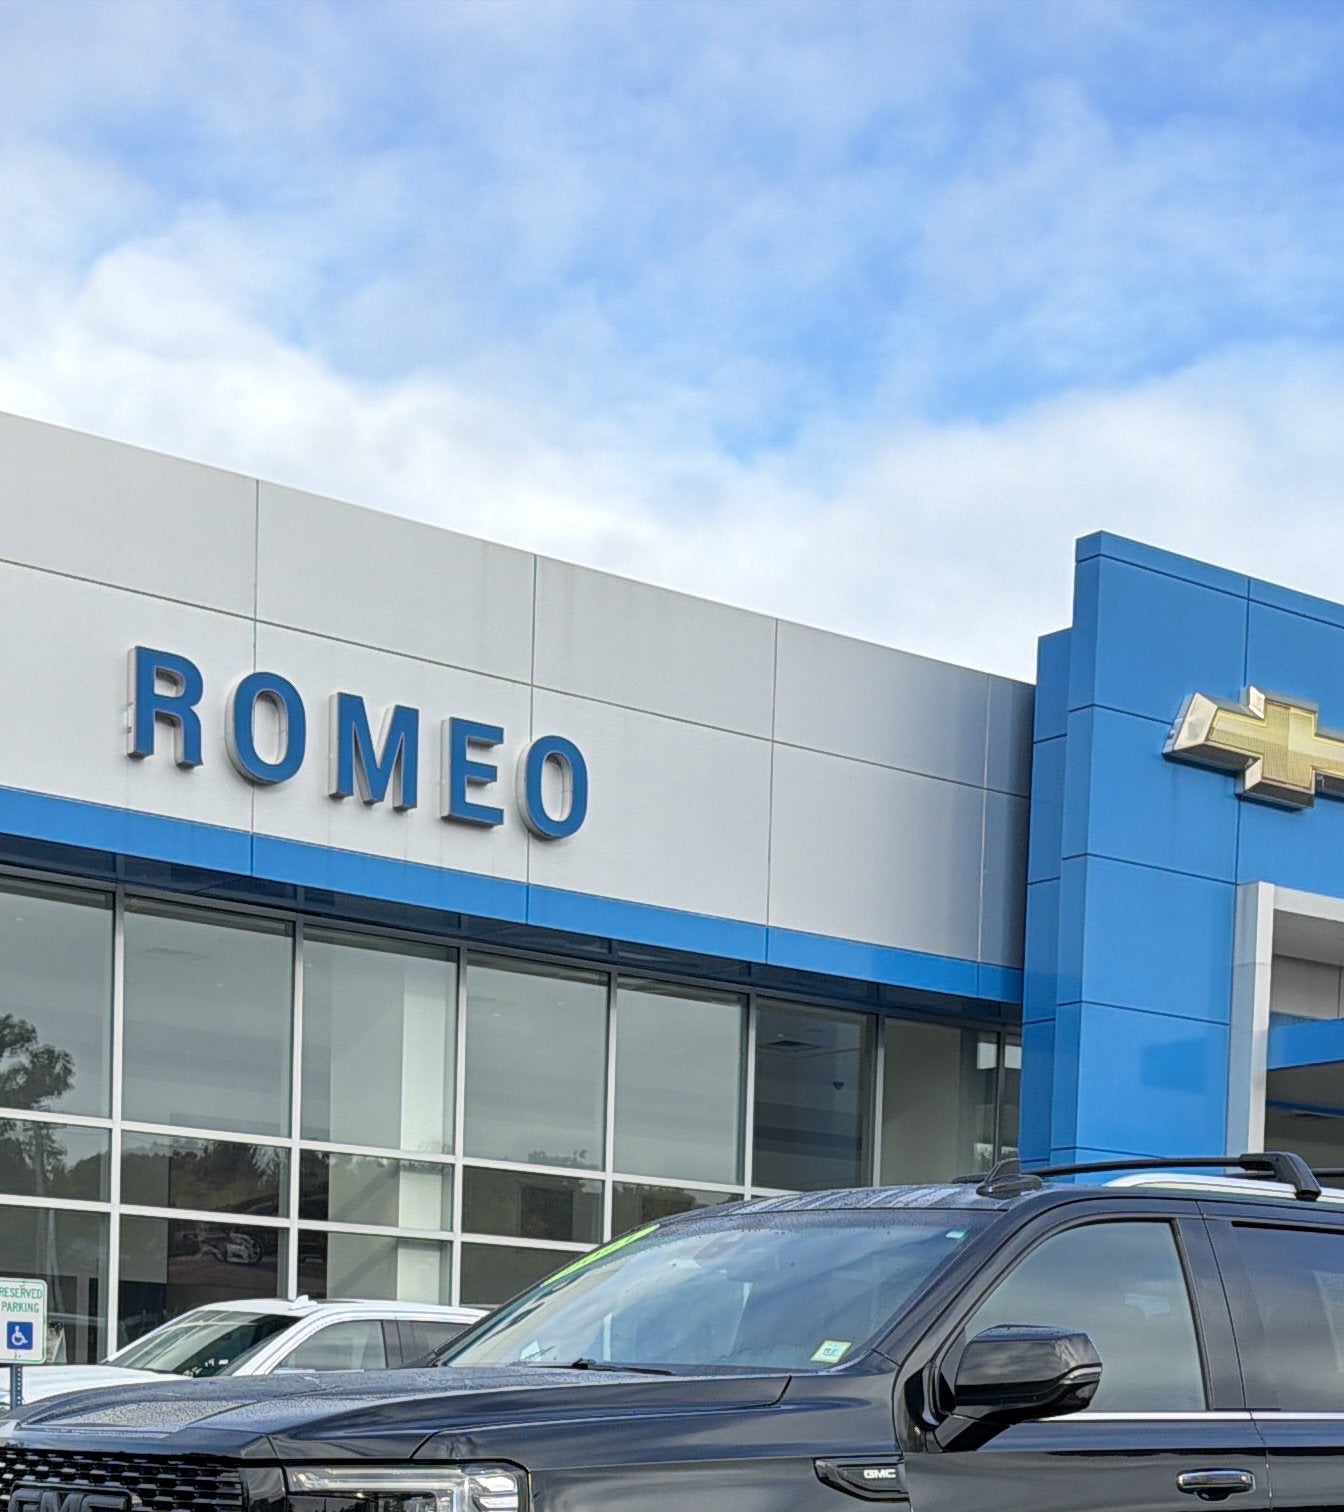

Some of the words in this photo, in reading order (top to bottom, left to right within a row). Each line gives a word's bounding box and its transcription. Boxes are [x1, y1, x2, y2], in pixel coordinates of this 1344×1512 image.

[127, 645, 589, 840] ROMEO
[1, 1301, 40, 1313] PARKING
[863, 1468, 897, 1479] GMC
